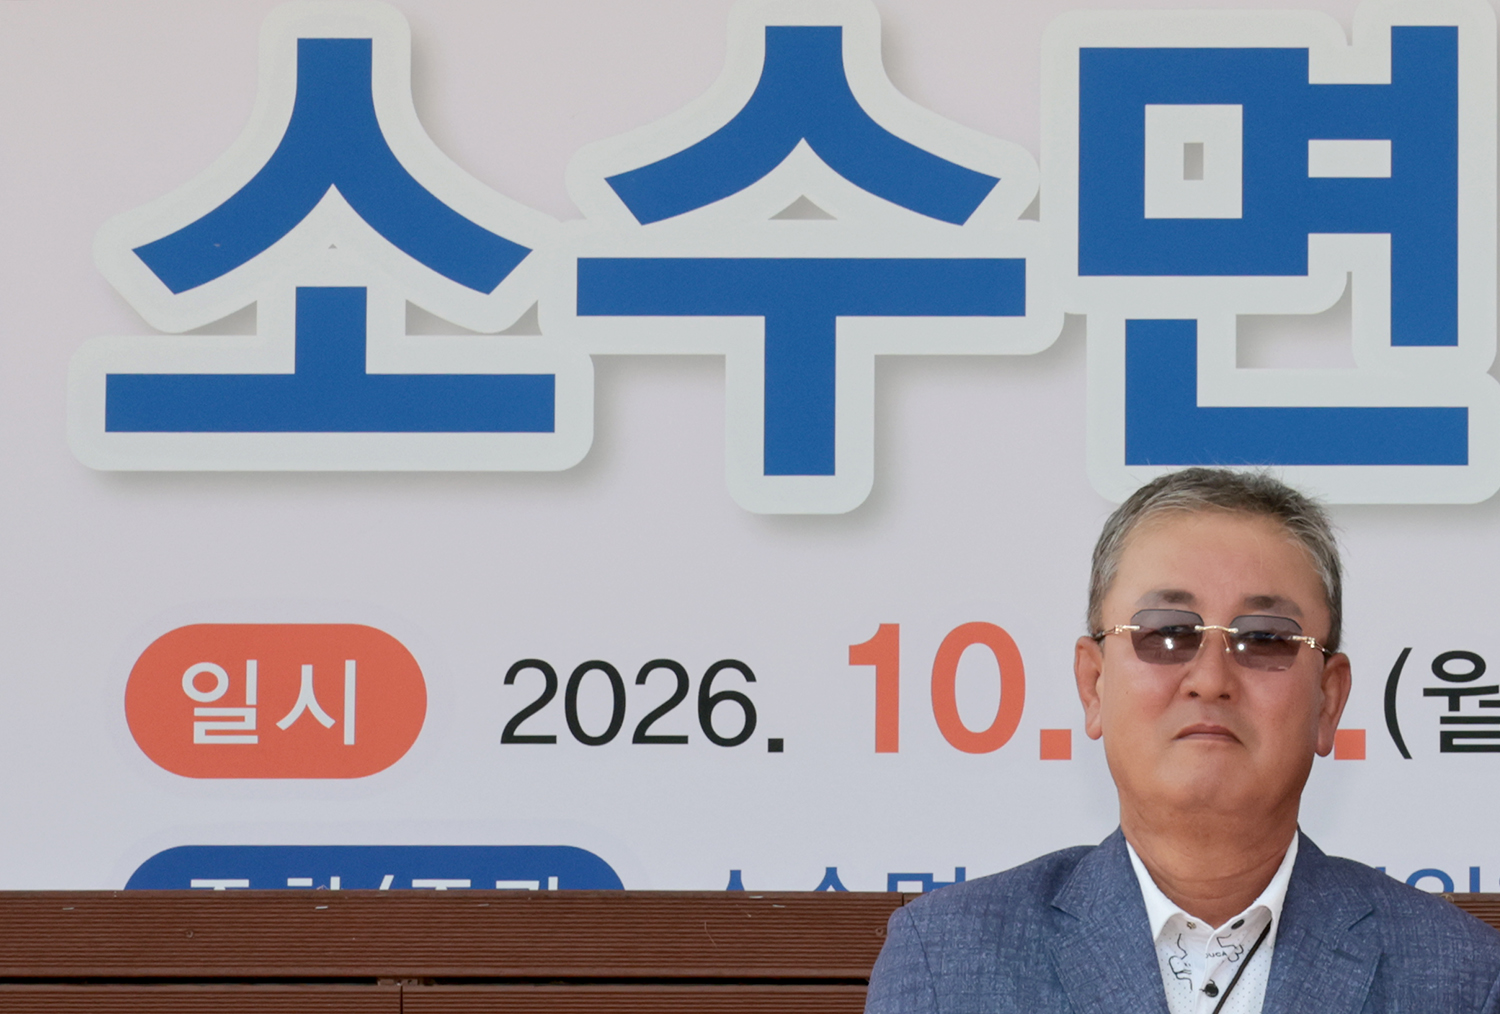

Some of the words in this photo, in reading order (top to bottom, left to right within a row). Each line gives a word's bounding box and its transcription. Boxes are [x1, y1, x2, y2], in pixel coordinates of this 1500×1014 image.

[104, 25, 1470, 476] 소수면
[180, 658, 358, 746] 일시
[499, 657, 785, 753] 2026.
